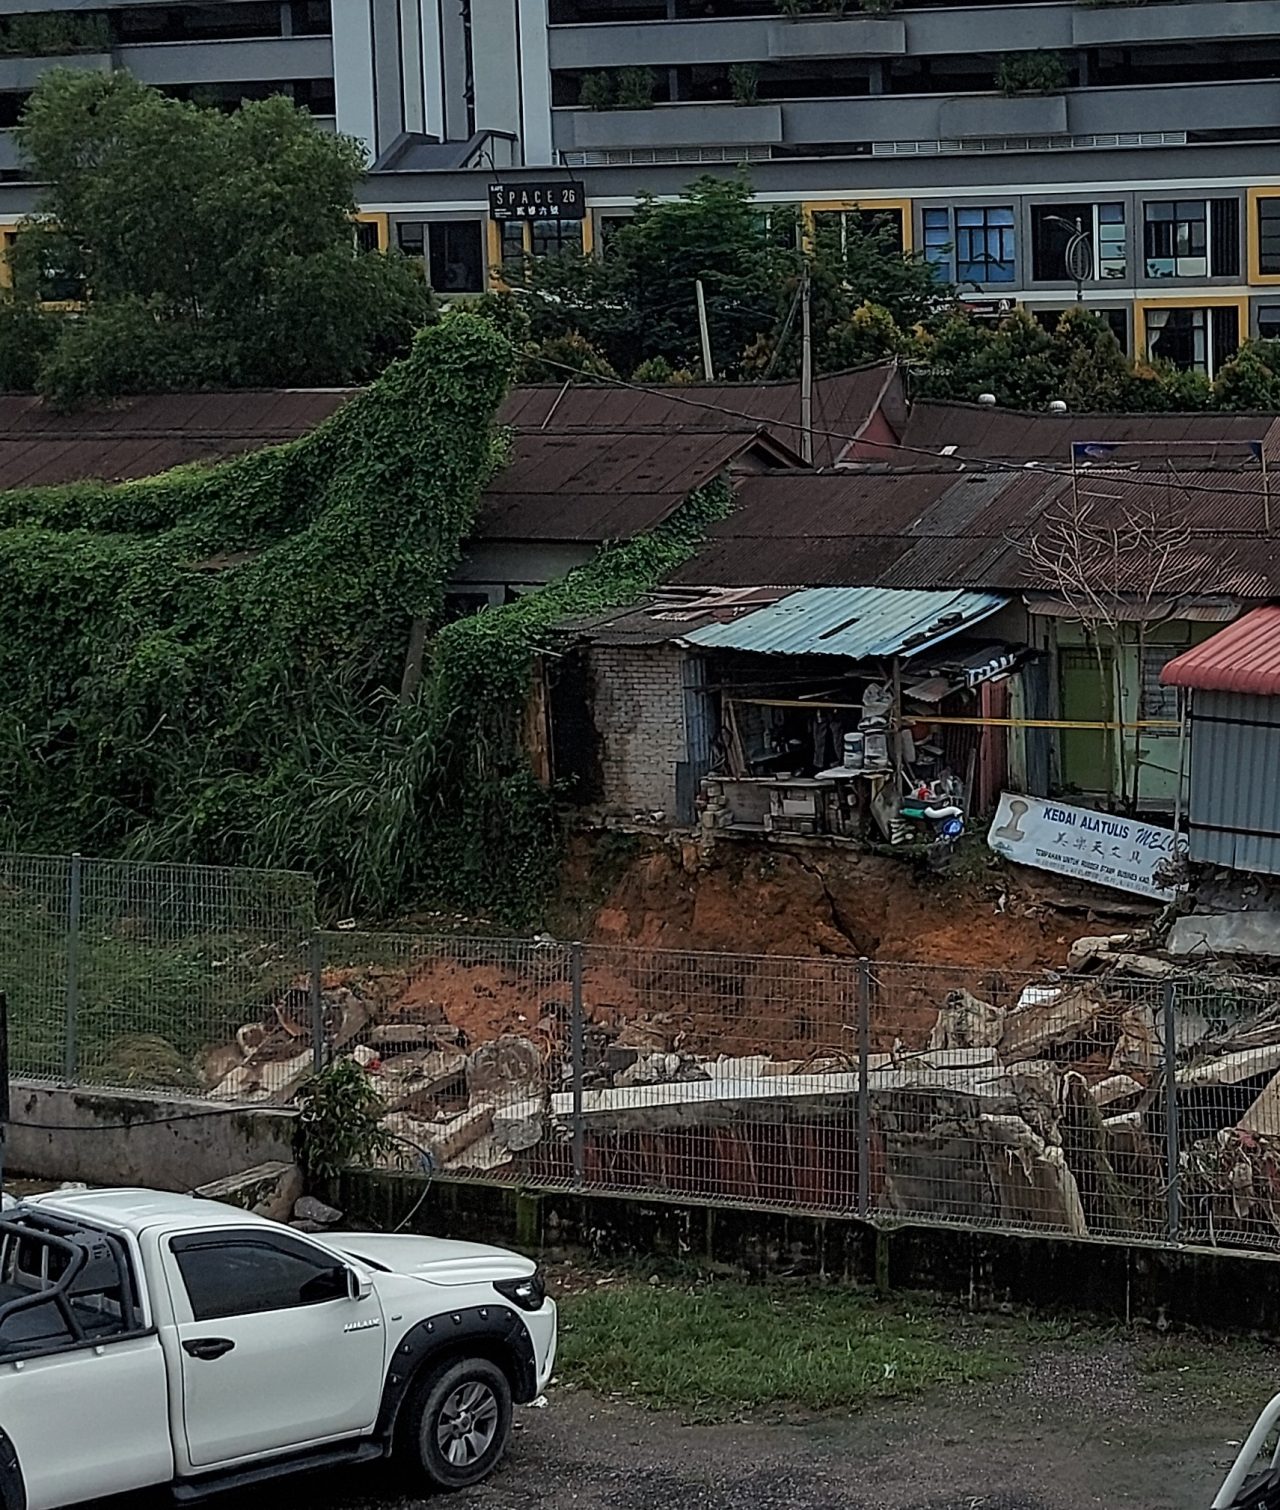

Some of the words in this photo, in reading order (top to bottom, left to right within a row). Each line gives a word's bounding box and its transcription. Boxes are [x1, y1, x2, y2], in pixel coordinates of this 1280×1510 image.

[496, 190, 554, 205] SPACE
[561, 189, 576, 203] 26
[1043, 807, 1077, 826] KEDAI
[1080, 816, 1130, 839] ALATULIS
